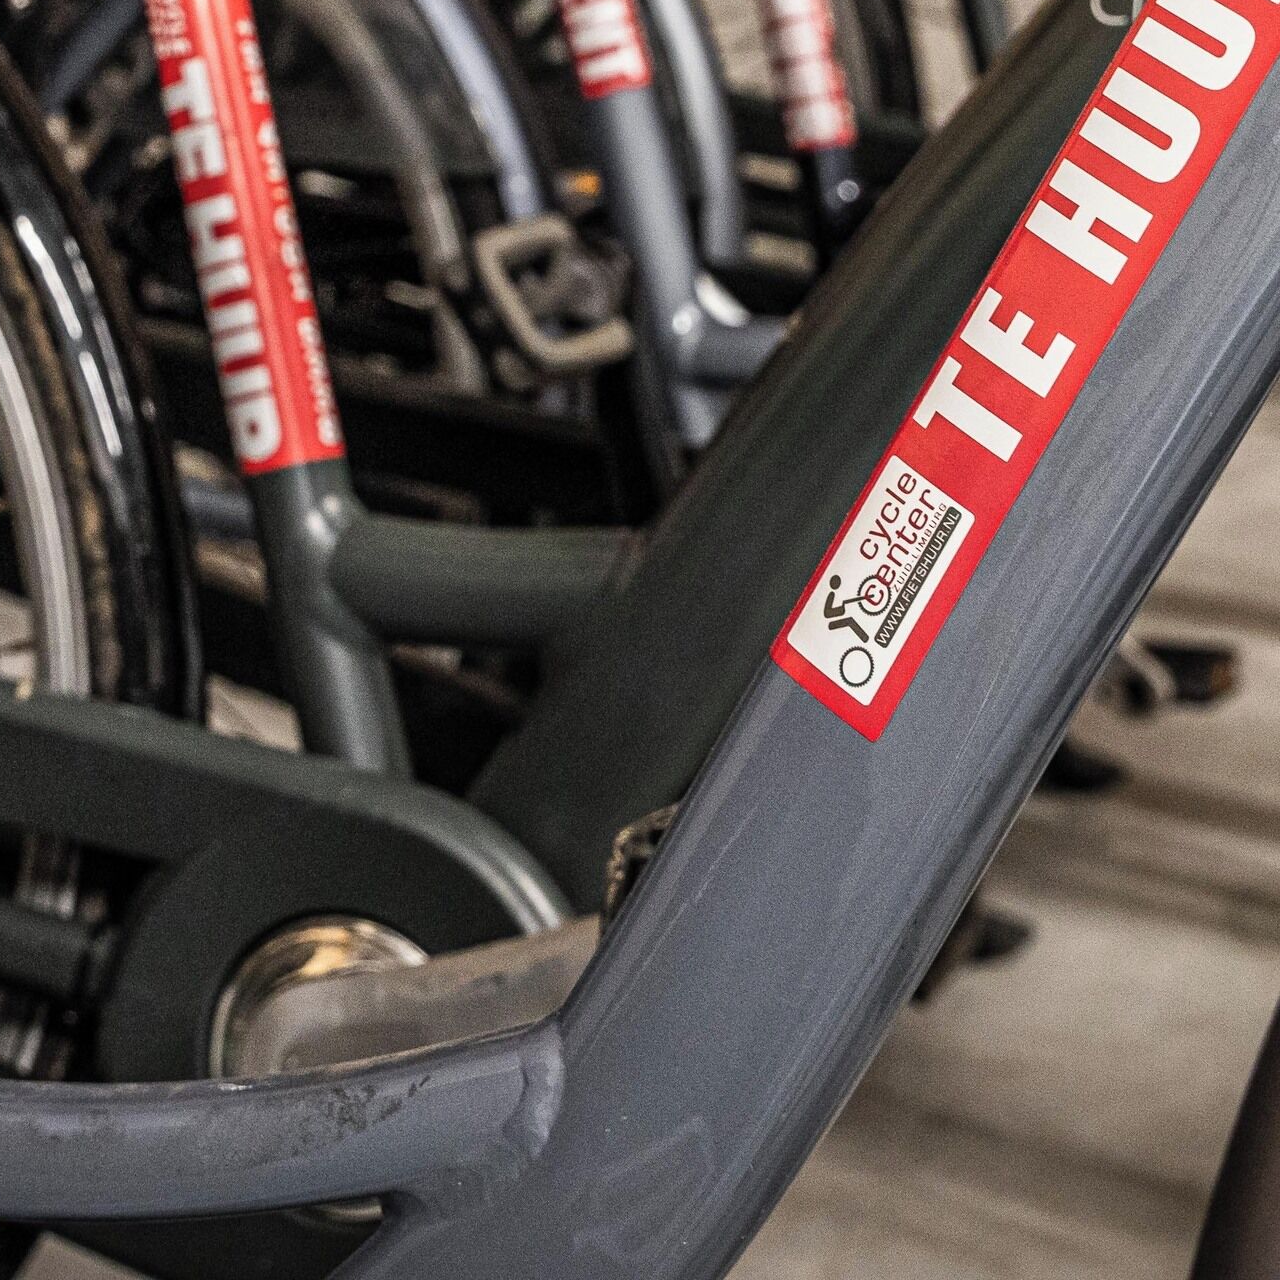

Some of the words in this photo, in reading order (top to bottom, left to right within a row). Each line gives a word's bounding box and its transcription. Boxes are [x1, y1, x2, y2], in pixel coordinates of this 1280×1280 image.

[912, 286, 1077, 464] TE
[859, 471, 918, 561] cycle
[863, 487, 936, 608] center
[874, 509, 962, 646] WWW.FIETSHUUR.NL
